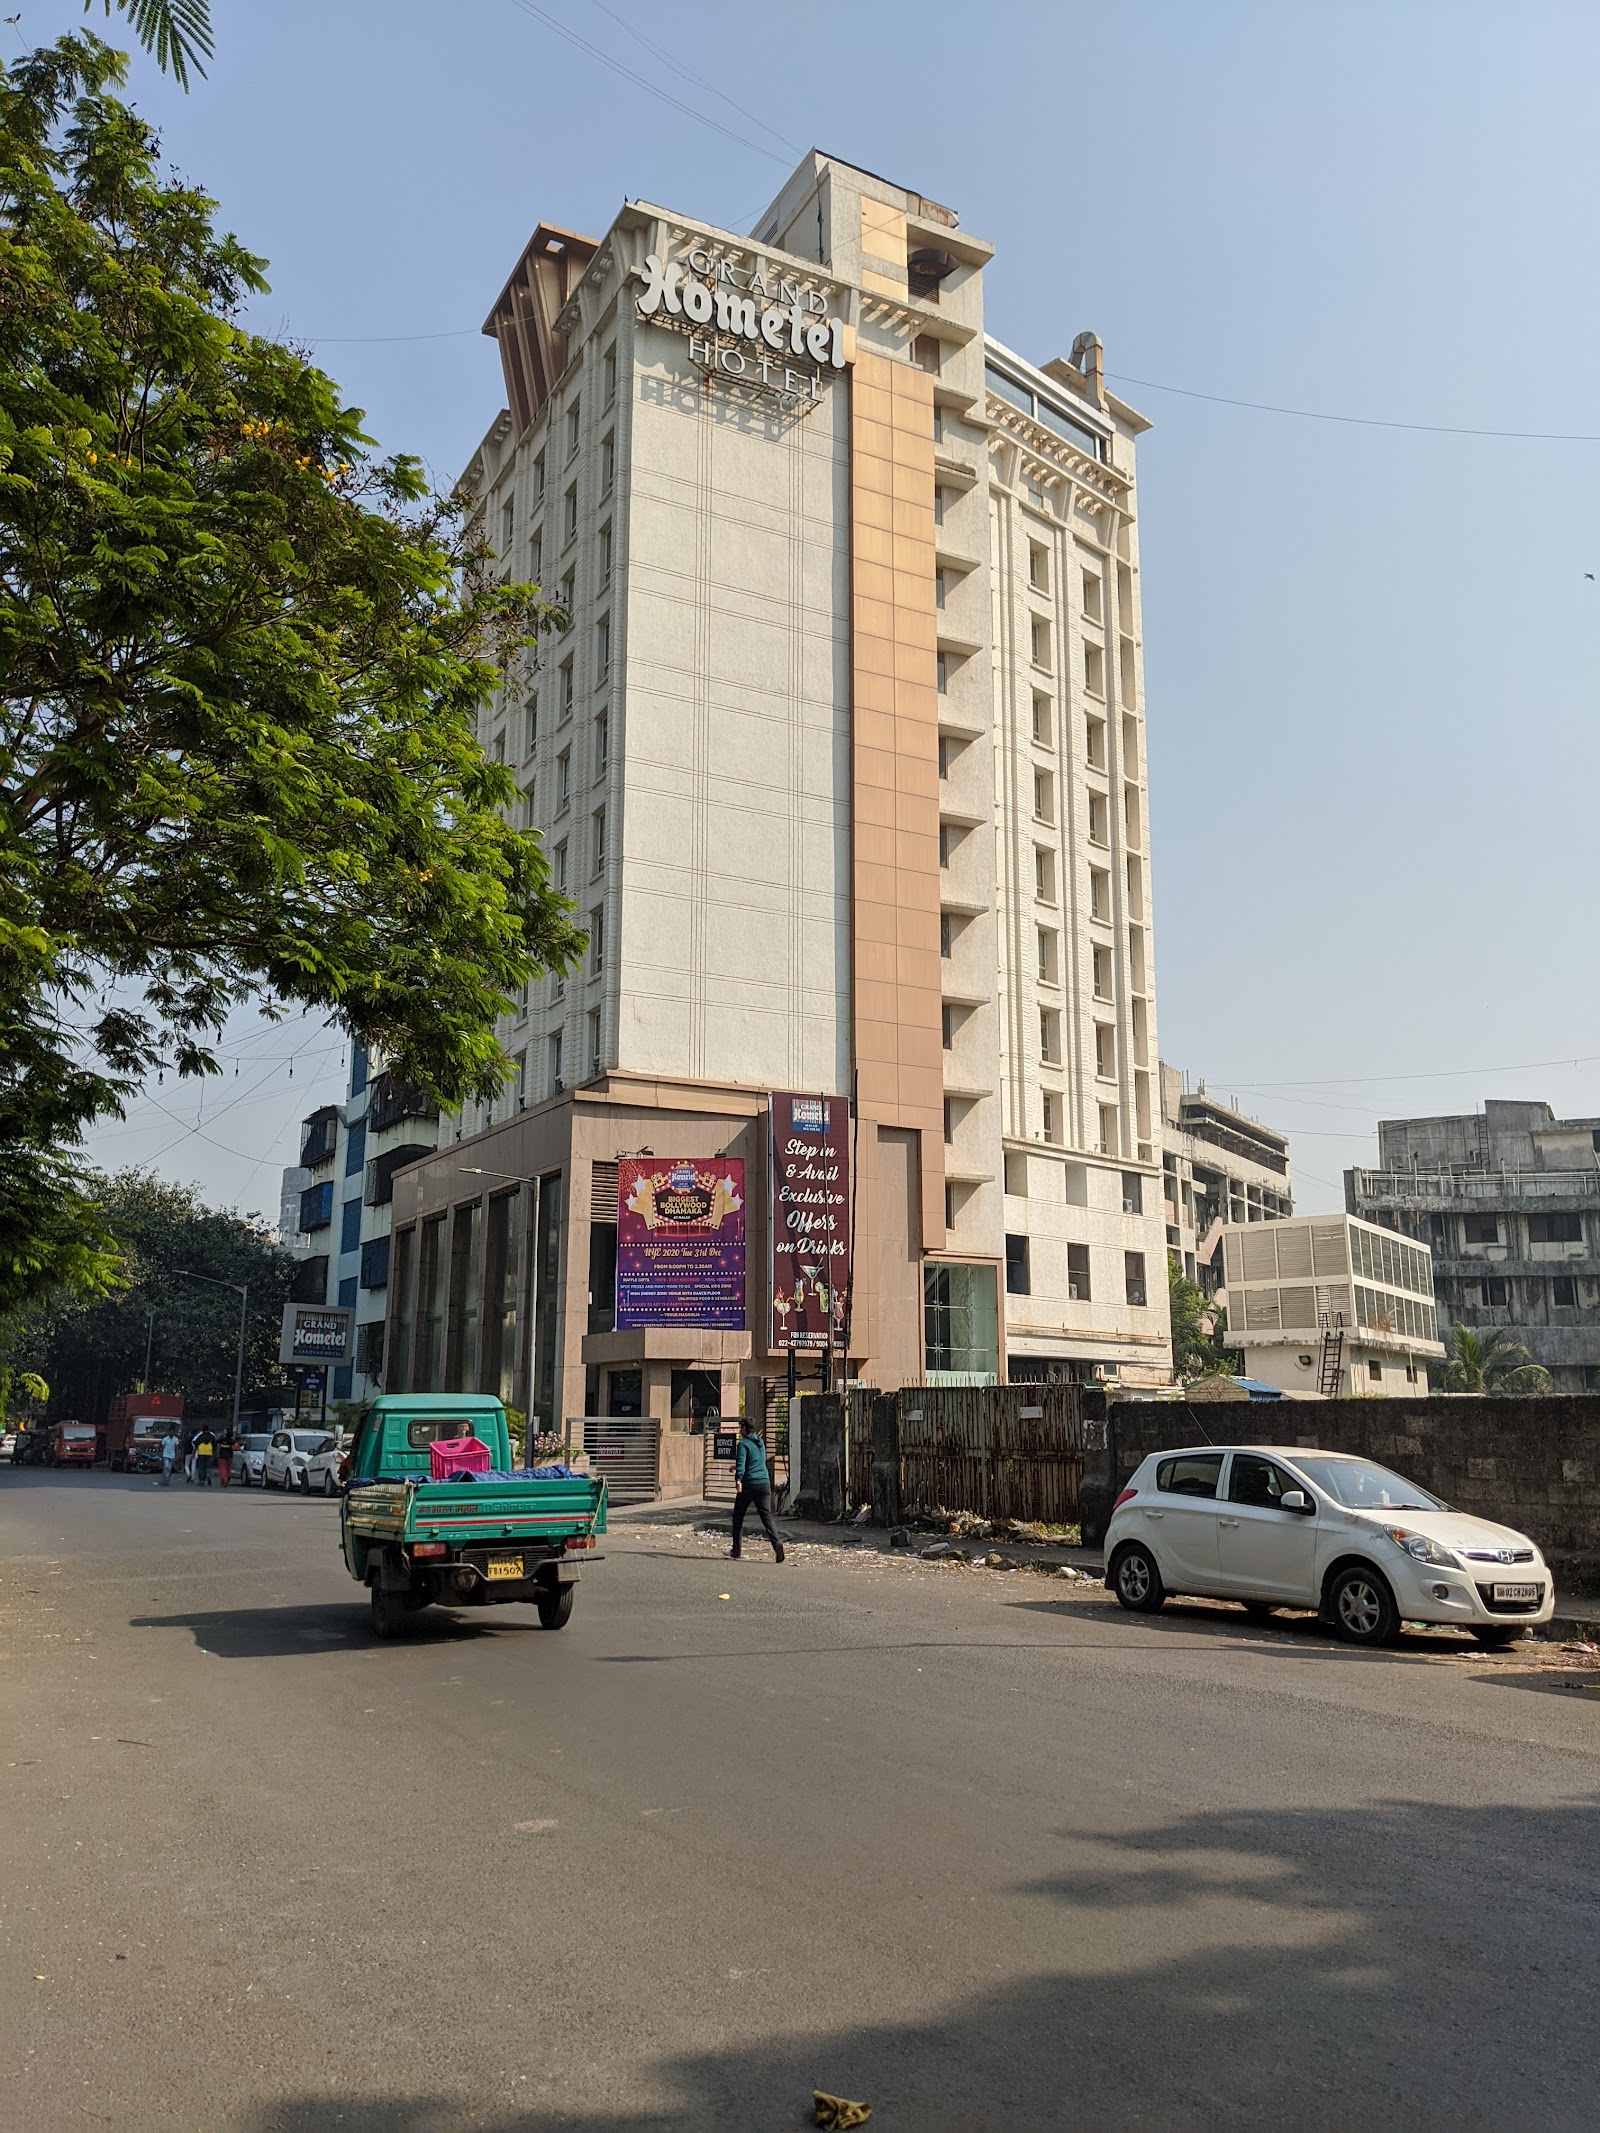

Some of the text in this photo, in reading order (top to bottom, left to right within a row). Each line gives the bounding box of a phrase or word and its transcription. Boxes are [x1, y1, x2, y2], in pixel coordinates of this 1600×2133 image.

[688, 250, 828, 316] GRAND
[635, 254, 846, 369] Hometel
[688, 336, 825, 402] HOTEL
[785, 1139, 819, 1160] Step
[786, 1164, 839, 1180] & Avail
[779, 1186, 845, 1204] Exclusive
[786, 1210, 838, 1233] Offers
[694, 1248, 708, 1257] 31st
[708, 1248, 722, 1256] Dec
[776, 1237, 847, 1255] on Drinks
[304, 1320, 337, 1330] GRAND
[294, 1329, 346, 1346] Hometel
